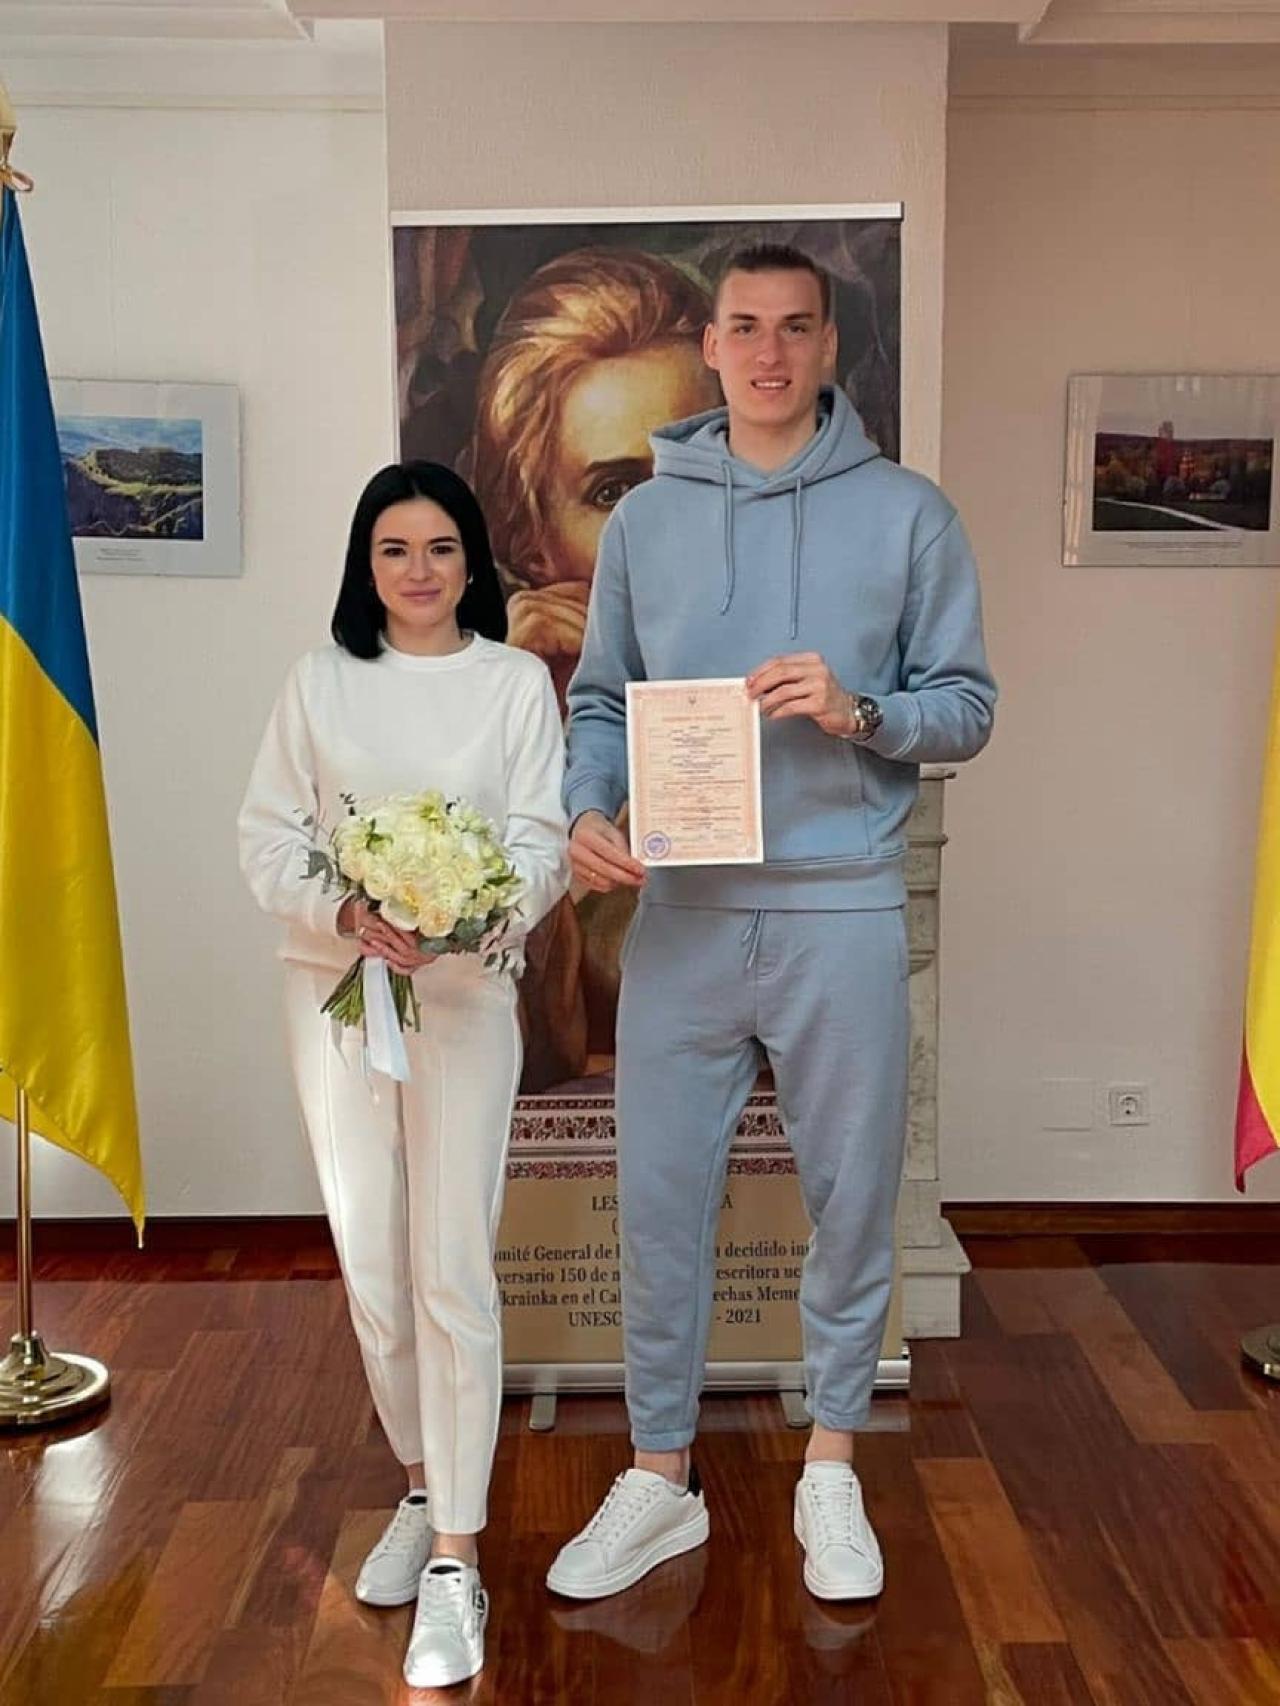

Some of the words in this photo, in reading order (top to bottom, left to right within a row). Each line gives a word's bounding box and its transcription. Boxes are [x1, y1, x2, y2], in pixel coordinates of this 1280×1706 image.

[591, 1195, 618, 1211] LES
[534, 1243, 590, 1260] General
[594, 1243, 613, 1259] de
[724, 1241, 787, 1257] decidido
[560, 1267, 587, 1282] 150
[590, 1266, 608, 1282] de
[716, 1264, 779, 1279] escritora
[500, 1289, 557, 1306] krainka
[561, 1293, 579, 1305] en
[583, 1288, 595, 1304] el
[713, 1286, 752, 1301] echas
[568, 1311, 622, 1327] UNESC
[725, 1308, 760, 1323] 2021
